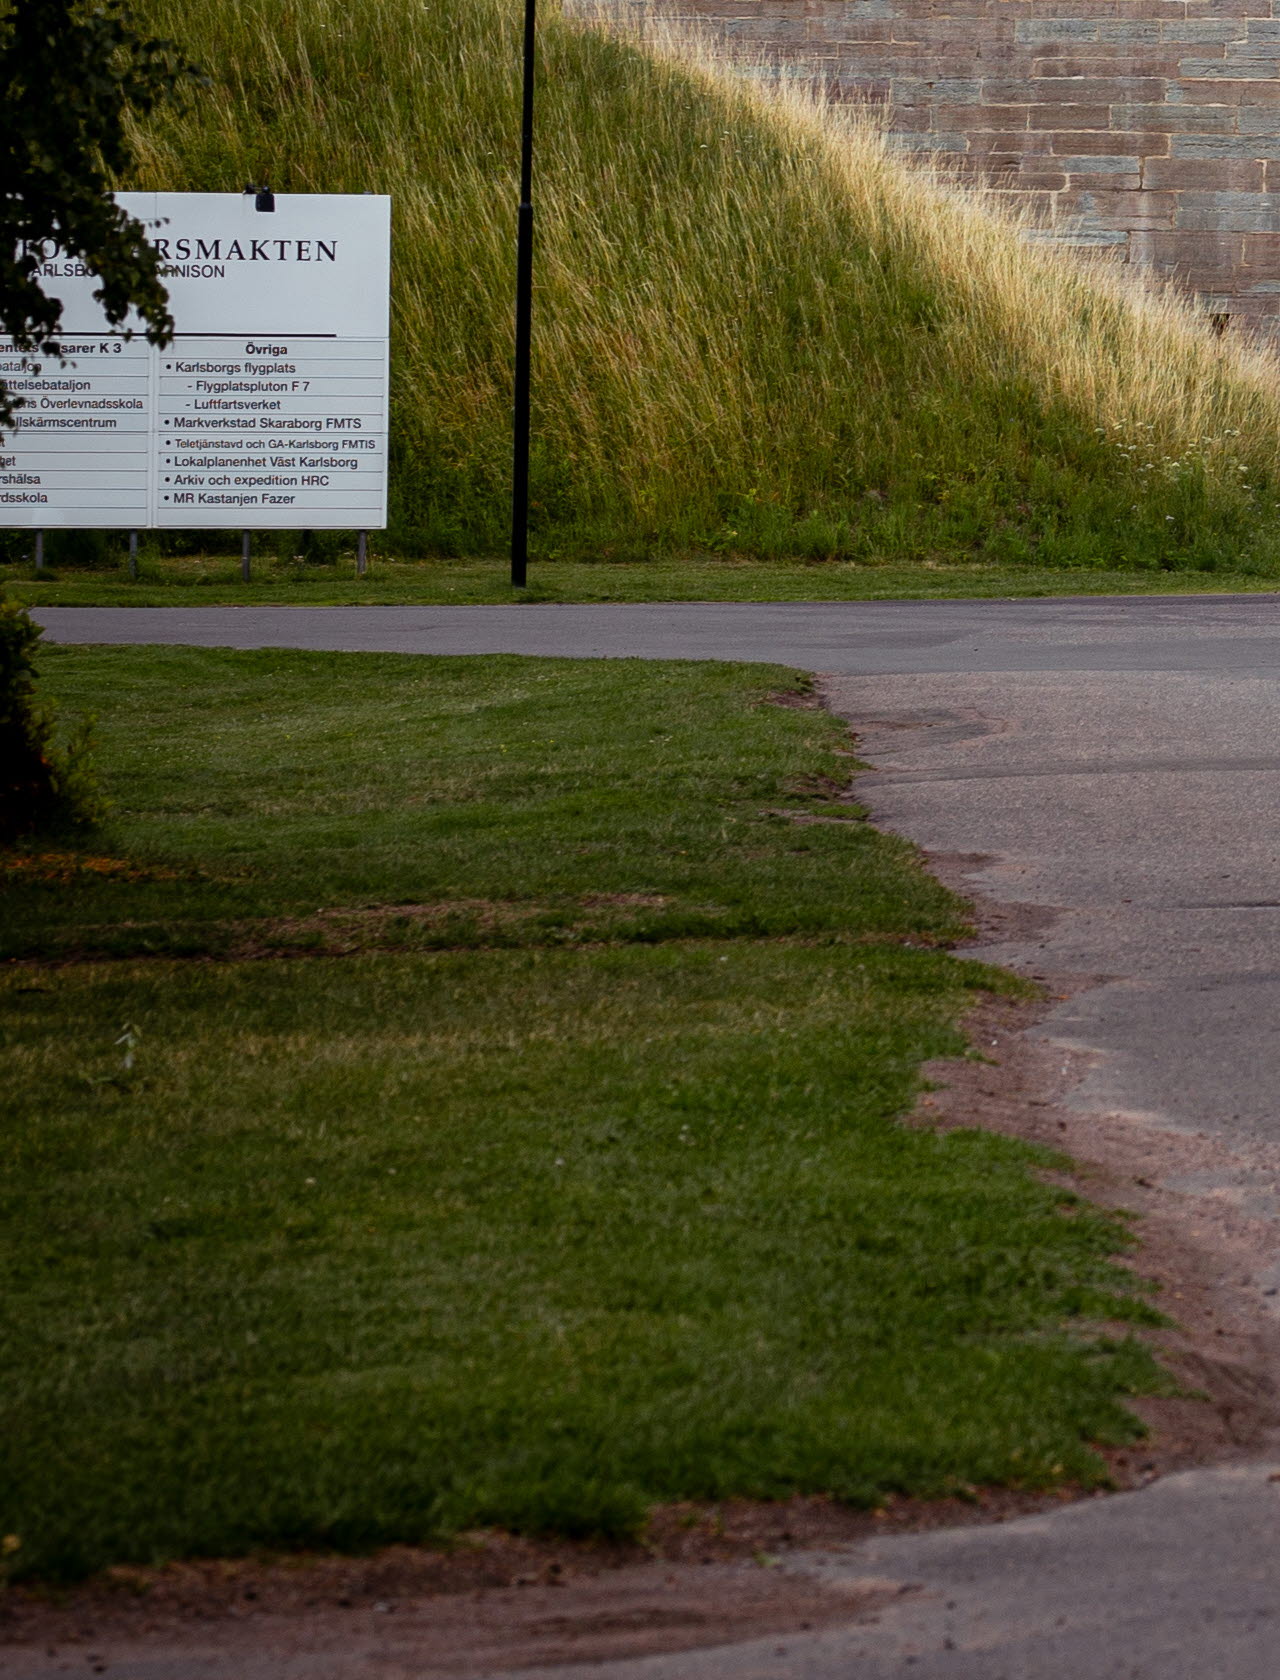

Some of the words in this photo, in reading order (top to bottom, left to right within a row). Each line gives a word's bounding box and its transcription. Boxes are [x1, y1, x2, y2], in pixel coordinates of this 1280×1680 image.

[142, 263, 225, 278] ARNISON
[99, 342, 110, 354] K
[112, 342, 122, 354] 3
[245, 341, 288, 357] Övriga
[175, 361, 242, 376] Karlsborgs
[243, 362, 297, 376] flygplats
[196, 380, 288, 394] Flygplatspluton
[291, 380, 300, 392] F
[302, 381, 311, 392] 7
[40, 394, 145, 410] Överlevnadsskola
[194, 398, 281, 410] Luftfartsverket
[173, 416, 257, 429] Markverkstad
[259, 417, 323, 433] Skaraborg
[325, 417, 362, 429] FMTS
[174, 438, 244, 451] Teletjänstavd
[245, 439, 266, 449] och
[267, 438, 339, 452] GA-Karlsborg
[174, 455, 267, 470] Lokalplanenhet
[269, 456, 296, 468] Väst
[299, 456, 358, 471] Karlsborg
[173, 474, 205, 486] Arkiv
[207, 474, 231, 486] och
[233, 474, 298, 488] expedition
[301, 474, 330, 487] HRC
[173, 492, 195, 504] MR
[197, 492, 258, 507] Kastanjen
[261, 493, 296, 505] Fazer
